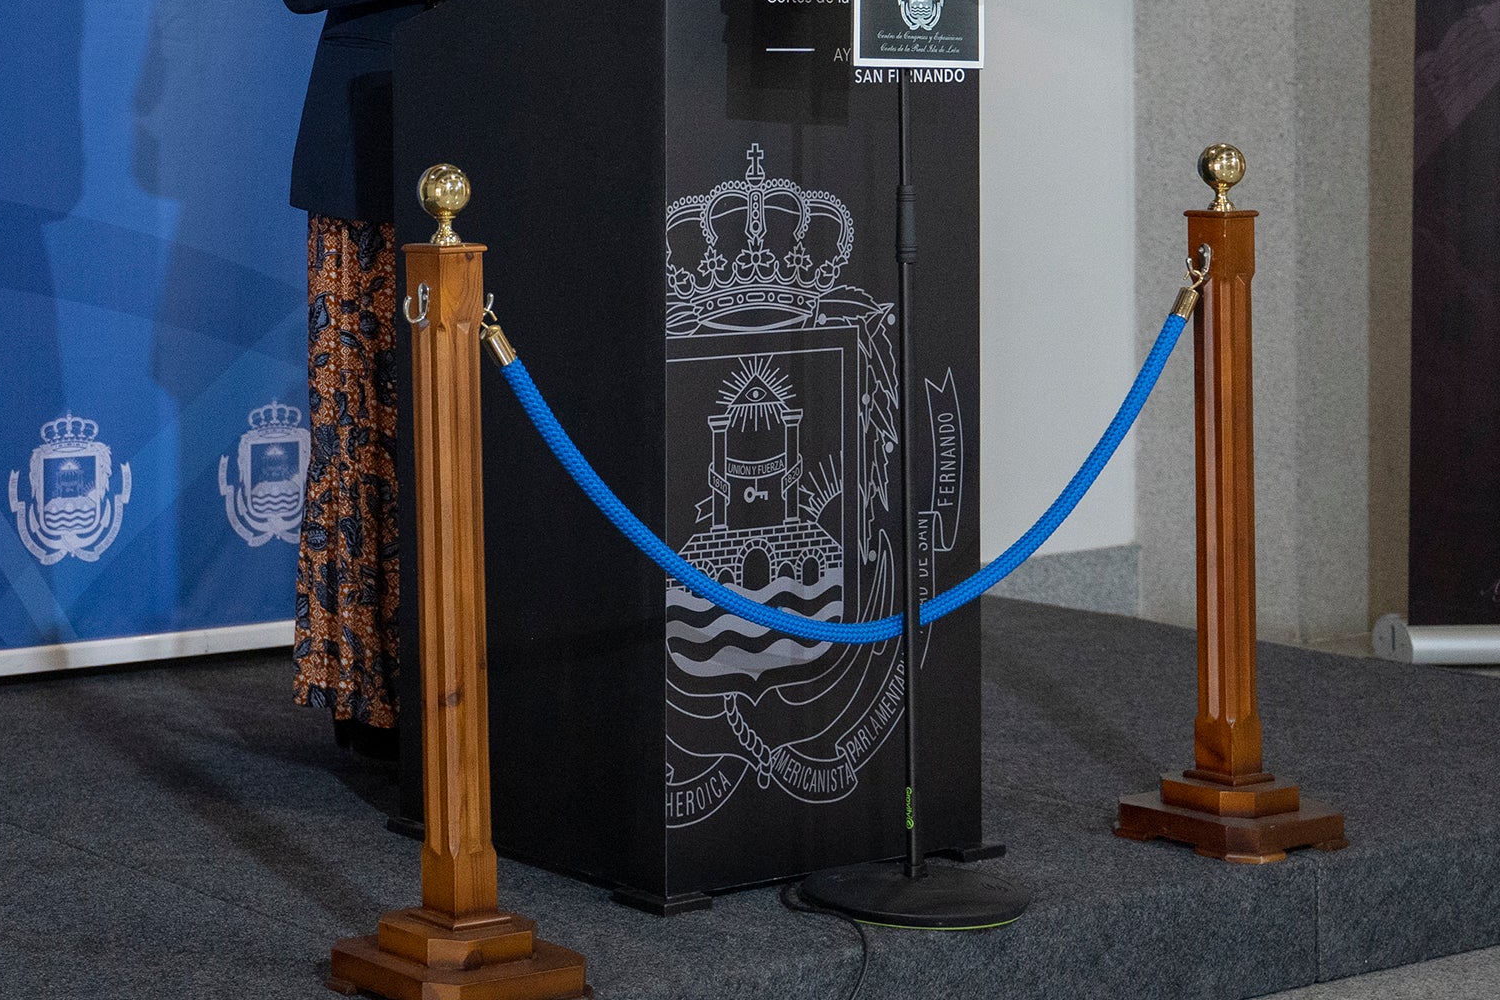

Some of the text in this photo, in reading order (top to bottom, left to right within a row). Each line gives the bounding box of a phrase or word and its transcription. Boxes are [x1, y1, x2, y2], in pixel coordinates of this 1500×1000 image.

[855, 68, 965, 83] SAN FNANDO
[727, 459, 784, 476] UNIÓN Y FUERZA
[938, 411, 955, 507] FERNANDO
[712, 475, 727, 493] 1810
[784, 467, 800, 486] 1820
[771, 750, 855, 793] AMERICANISTA
[665, 770, 732, 817] HEROICA
